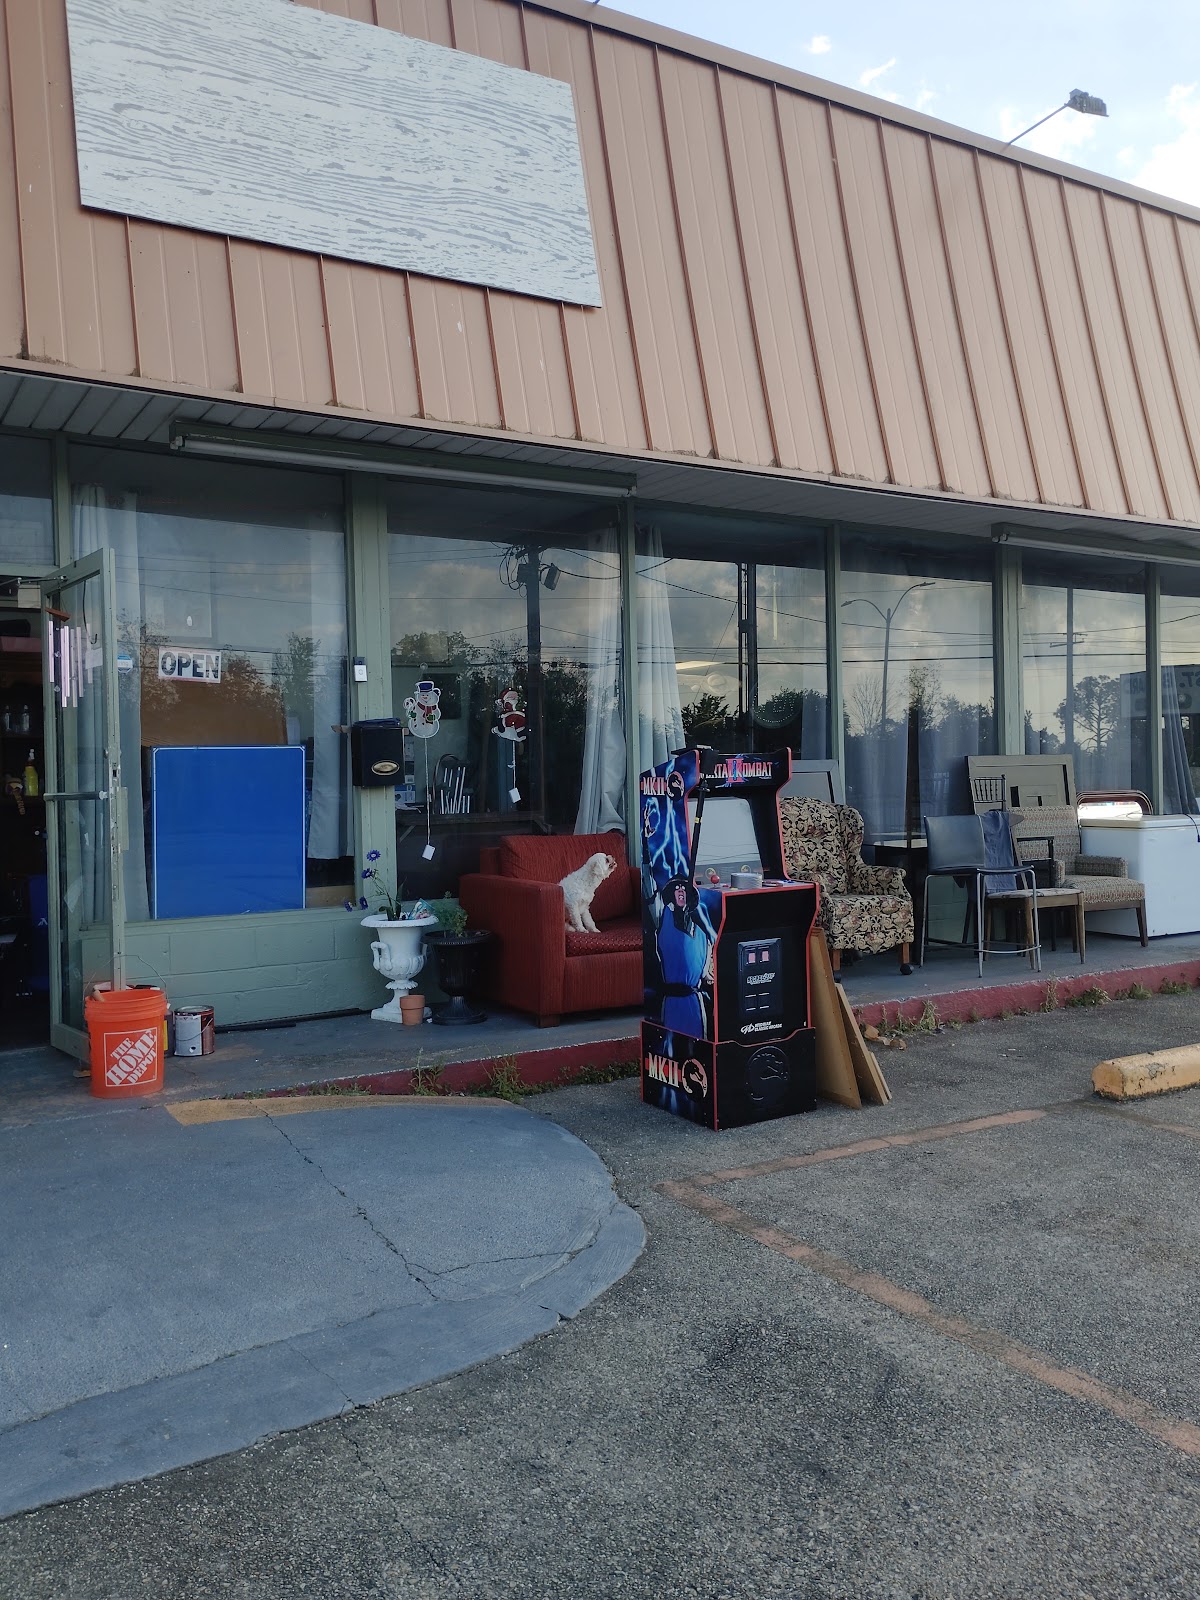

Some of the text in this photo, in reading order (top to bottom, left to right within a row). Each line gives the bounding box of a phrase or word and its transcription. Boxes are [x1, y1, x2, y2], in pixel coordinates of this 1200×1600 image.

[161, 652, 220, 679] OPEN
[736, 761, 773, 778] KOMBAT
[106, 1029, 157, 1085] HOME
[110, 1037, 135, 1060] THE
[126, 1047, 157, 1085] DEPOT
